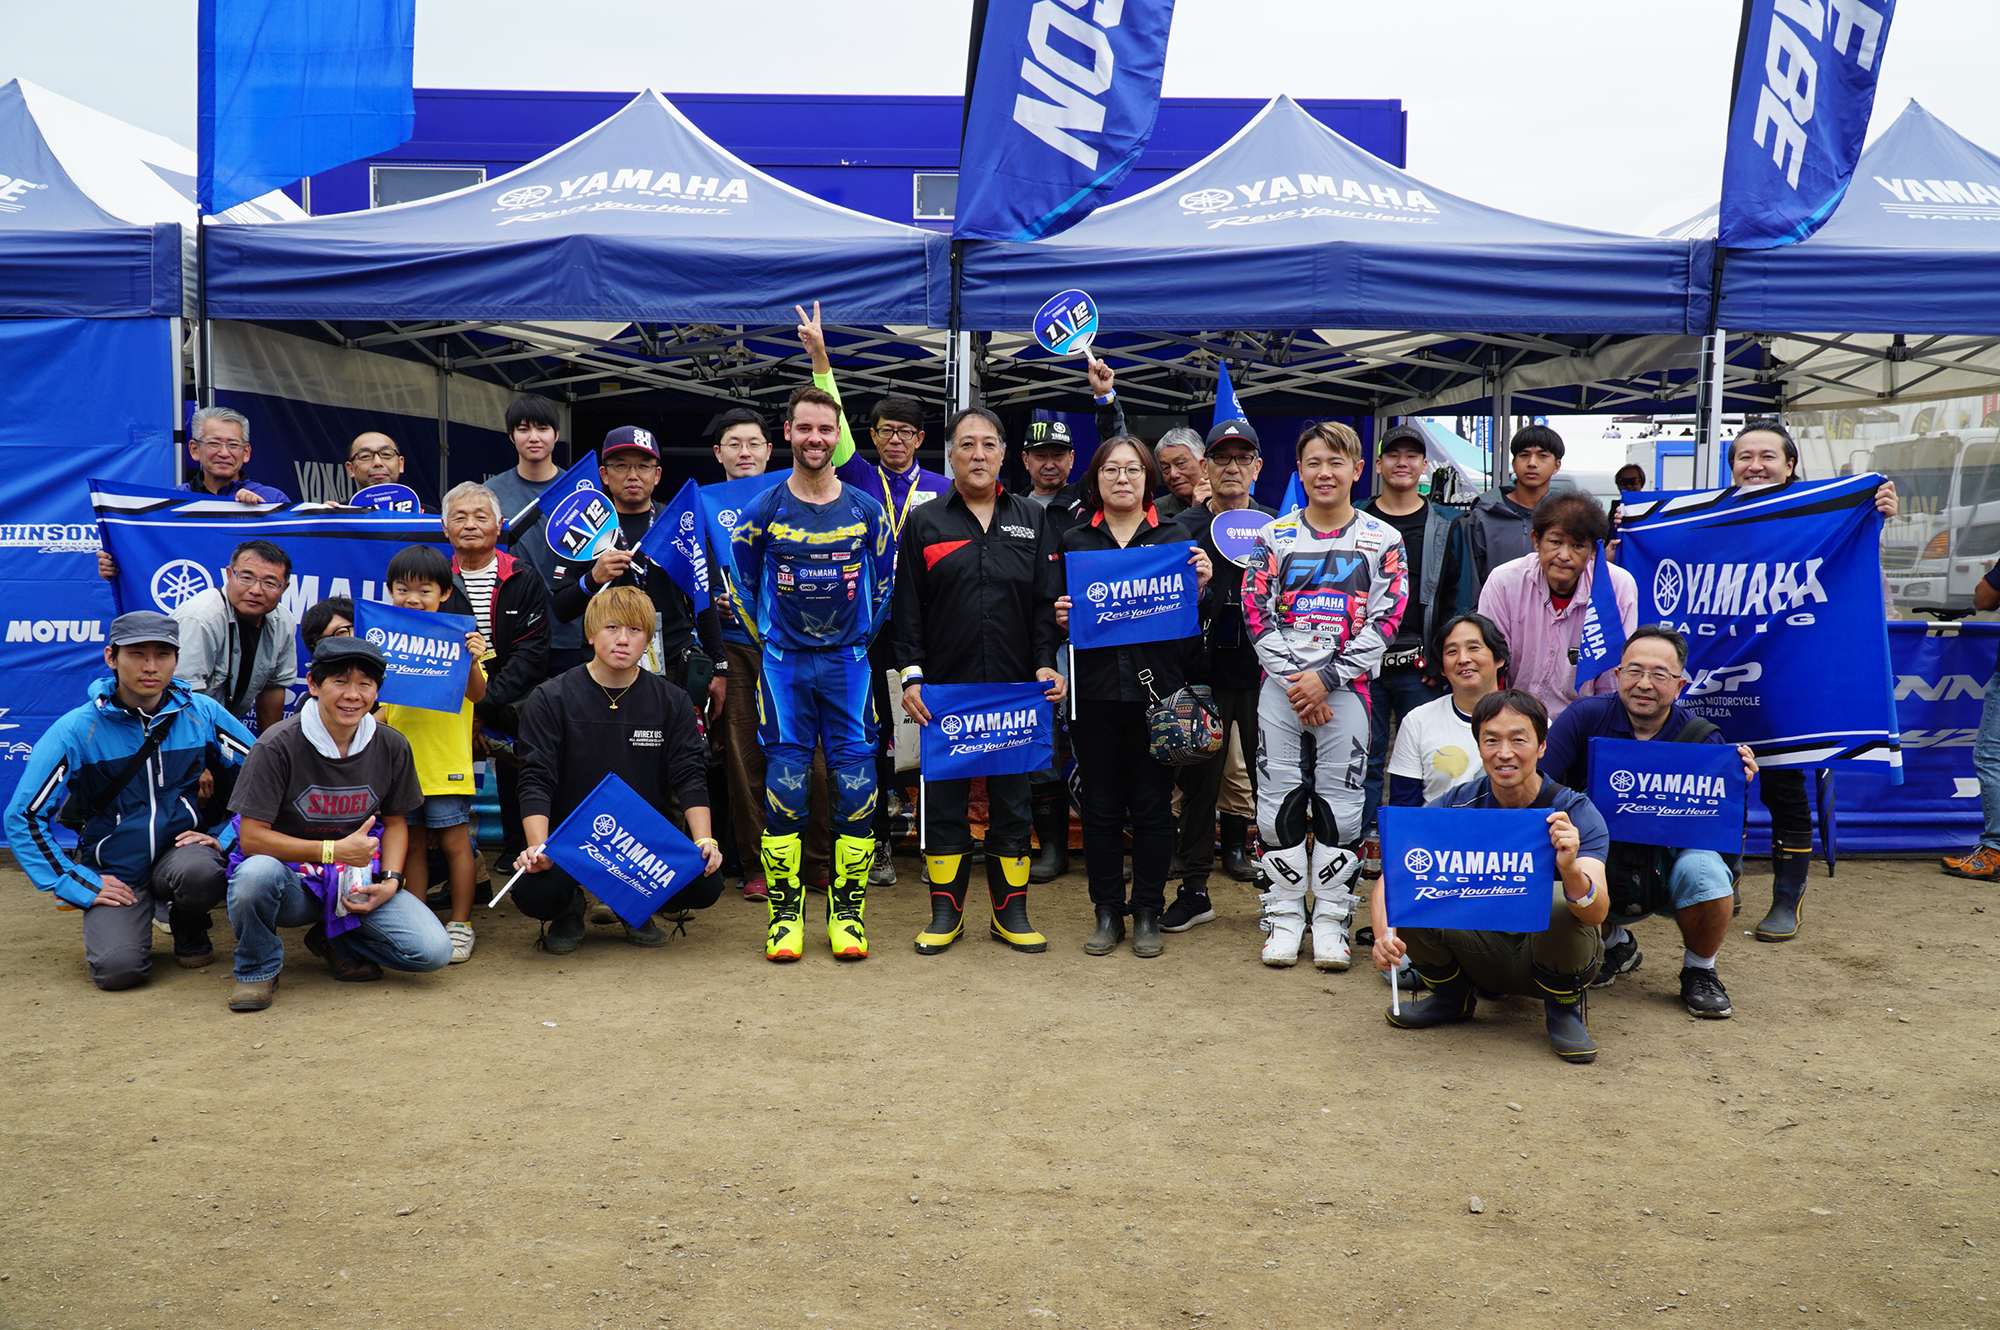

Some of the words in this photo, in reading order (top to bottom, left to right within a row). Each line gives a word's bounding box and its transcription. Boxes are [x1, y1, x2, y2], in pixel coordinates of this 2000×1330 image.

[560, 169, 748, 198] YAMAHA
[1236, 174, 1437, 210] YAMAHA
[496, 204, 591, 226] Revs
[588, 201, 658, 213] Your
[655, 204, 732, 215] Heart
[1205, 209, 1298, 229] Revs
[1300, 206, 1363, 219] Your
[1361, 212, 1437, 224] Heart
[1072, 300, 1088, 322] 12
[1045, 323, 1058, 341] 1
[586, 499, 604, 521] 12
[808, 569, 838, 577] YAMAHA
[1285, 557, 1363, 585] FLY
[1110, 573, 1184, 600] YAMAHA
[1686, 557, 1828, 616] YAMAHA
[1096, 594, 1180, 609] RACING
[1096, 610, 1131, 624] Revs
[1130, 608, 1156, 619] Your
[1154, 602, 1183, 614] Heart
[5, 620, 105, 642] MOTUL
[1320, 625, 1340, 633] SHOEI
[387, 631, 461, 661] YAMAHA
[382, 651, 452, 667] ACING
[396, 663, 424, 675] Your
[422, 668, 450, 676] Heart
[1705, 696, 1760, 706] MOTORCYCLE
[963, 709, 1038, 733] YAMAHA
[1706, 708, 1732, 717] PLAZA
[633, 730, 654, 739] AVIREX
[654, 731, 663, 739] US
[949, 729, 1033, 741] RACING
[949, 743, 985, 757] Revs
[983, 741, 1009, 753] Your
[1006, 736, 1035, 749] Heart
[1637, 772, 1726, 798] YAMAHA
[307, 793, 369, 815] SHOEI
[1616, 802, 1657, 814] Revs
[1656, 806, 1686, 816] Your
[1684, 807, 1719, 816] Heart
[1618, 793, 1719, 806] RACING
[578, 840, 614, 869] Revs
[606, 863, 632, 882] Your
[628, 877, 653, 896] Heart
[591, 832, 659, 890] RACING
[610, 826, 677, 889] YAMAHA
[1434, 850, 1534, 875] YAMAHA
[1415, 875, 1527, 883] RACING
[1414, 887, 1460, 901] Revs
[1460, 886, 1495, 898] Your
[1490, 885, 1527, 896] Heart
